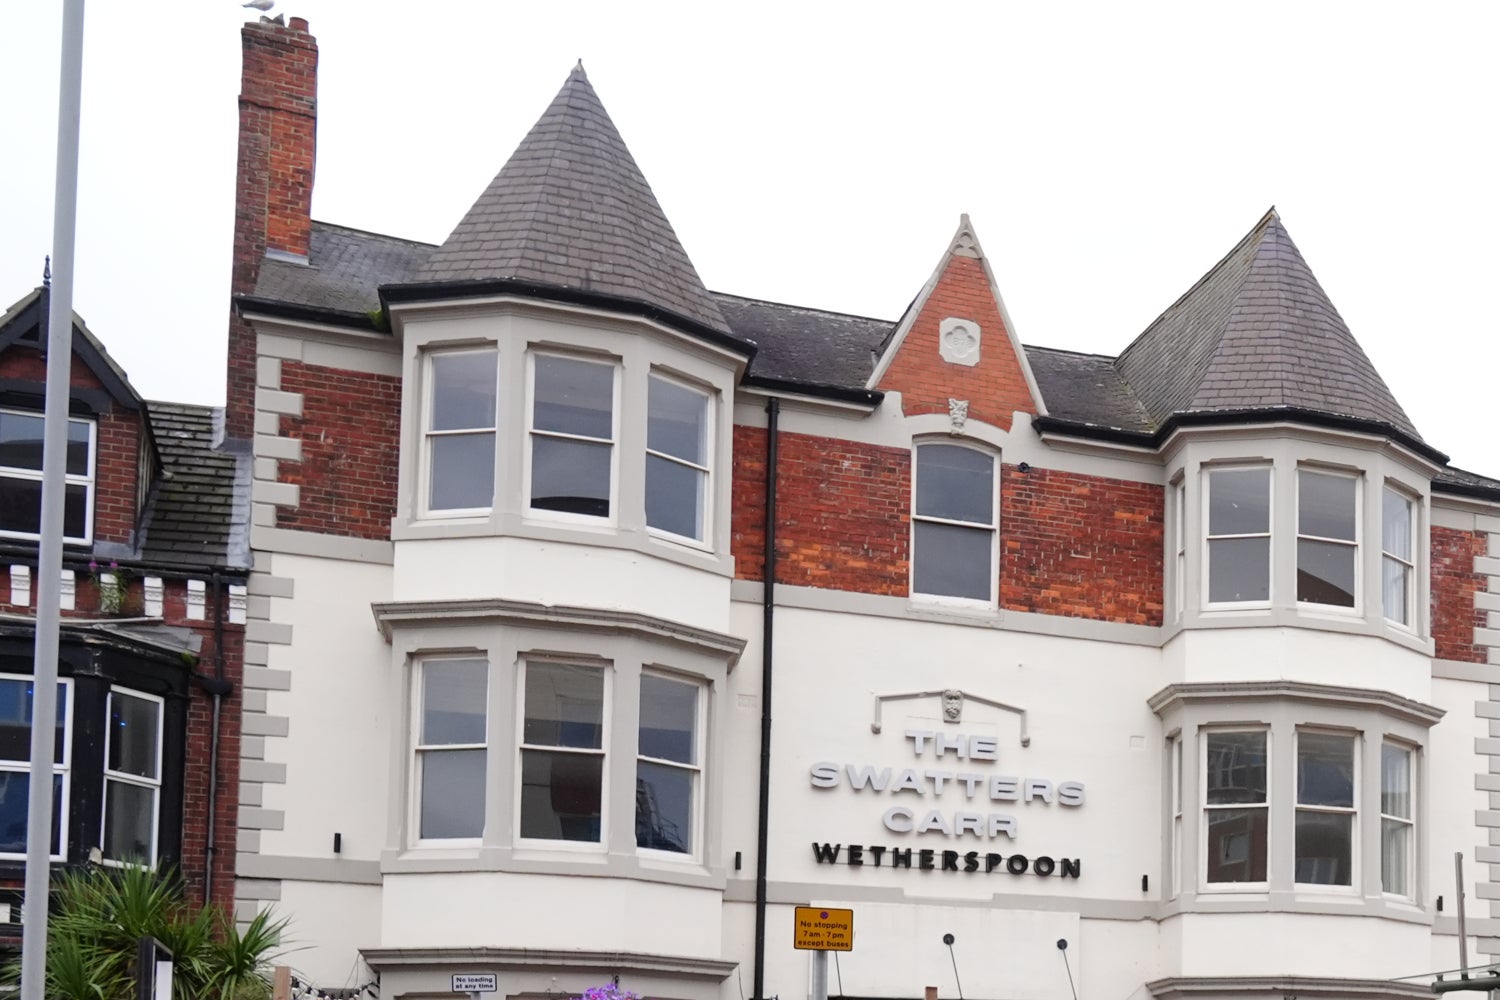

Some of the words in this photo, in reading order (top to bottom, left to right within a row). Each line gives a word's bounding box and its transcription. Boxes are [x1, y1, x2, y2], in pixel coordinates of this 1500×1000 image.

[905, 729, 998, 761] THE
[810, 762, 1086, 807] SWATTERS
[883, 807, 1018, 839] CARR
[812, 842, 1081, 879] WETHERSPOON
[814, 922, 848, 930] stopping
